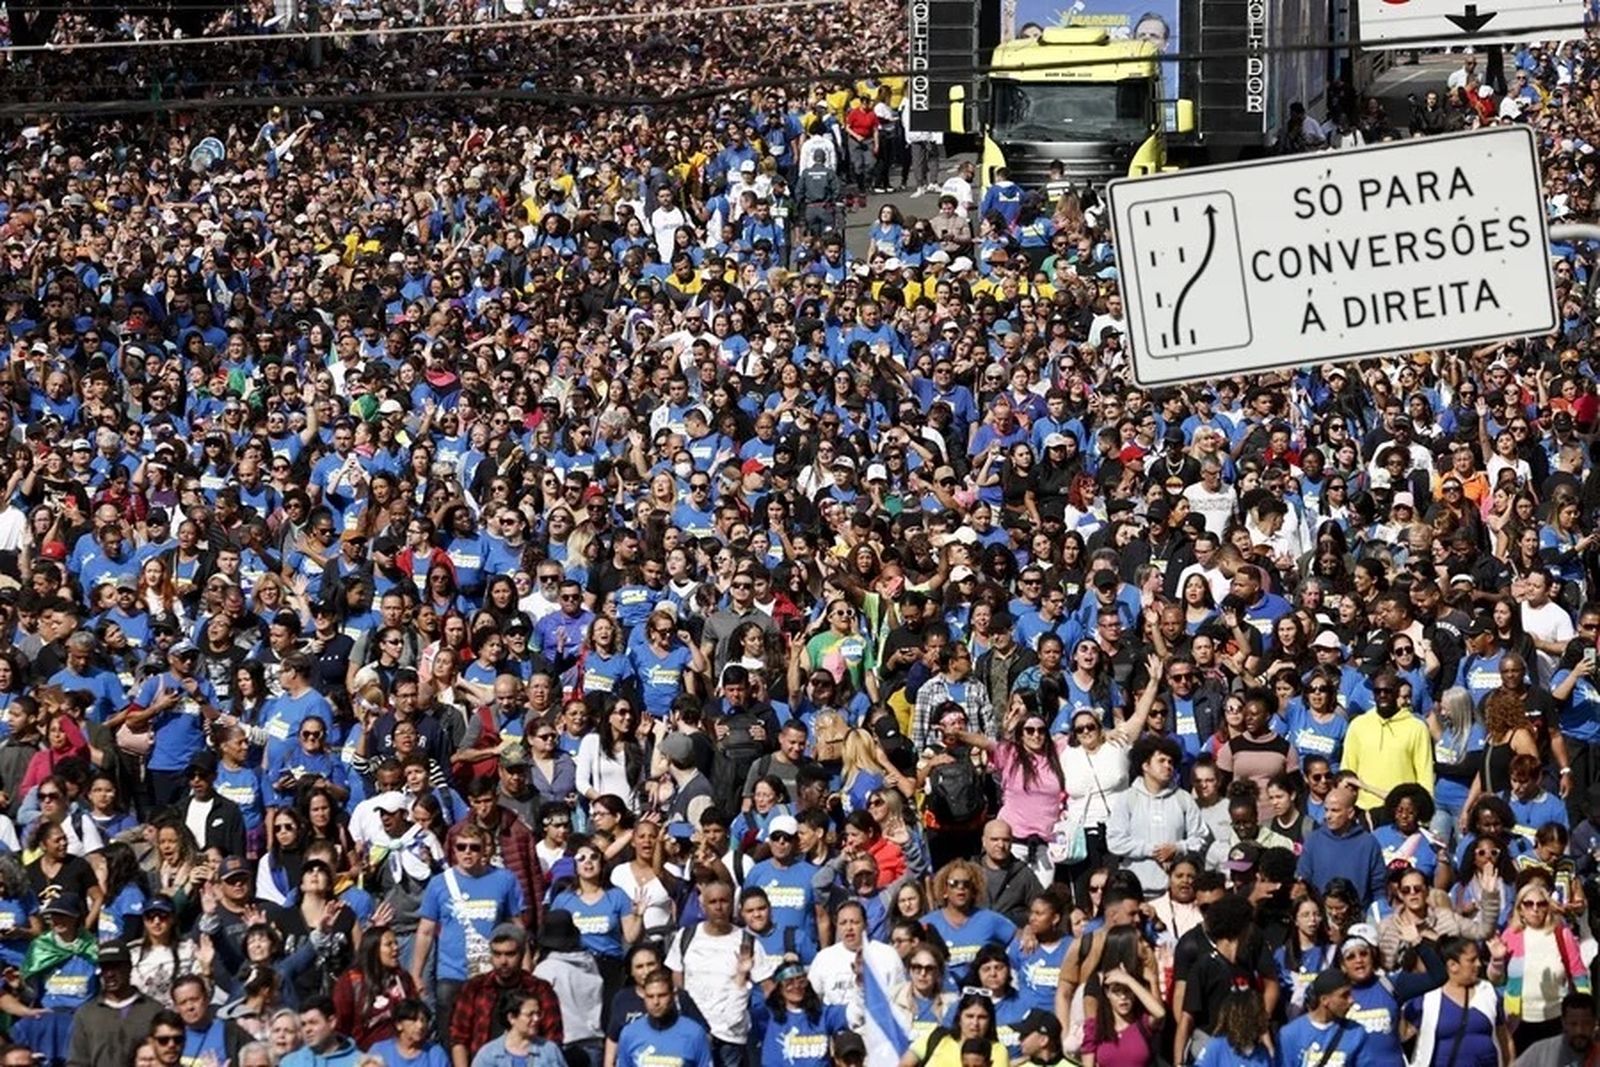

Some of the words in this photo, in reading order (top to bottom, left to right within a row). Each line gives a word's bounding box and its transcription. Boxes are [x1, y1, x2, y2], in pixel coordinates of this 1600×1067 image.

[913, 0, 929, 111] OLIDOR
[1247, 0, 1264, 112] OLIDOR
[1293, 169, 1343, 219] SÓ
[1359, 166, 1474, 211] PARA
[1343, 278, 1500, 328] DIREITA
